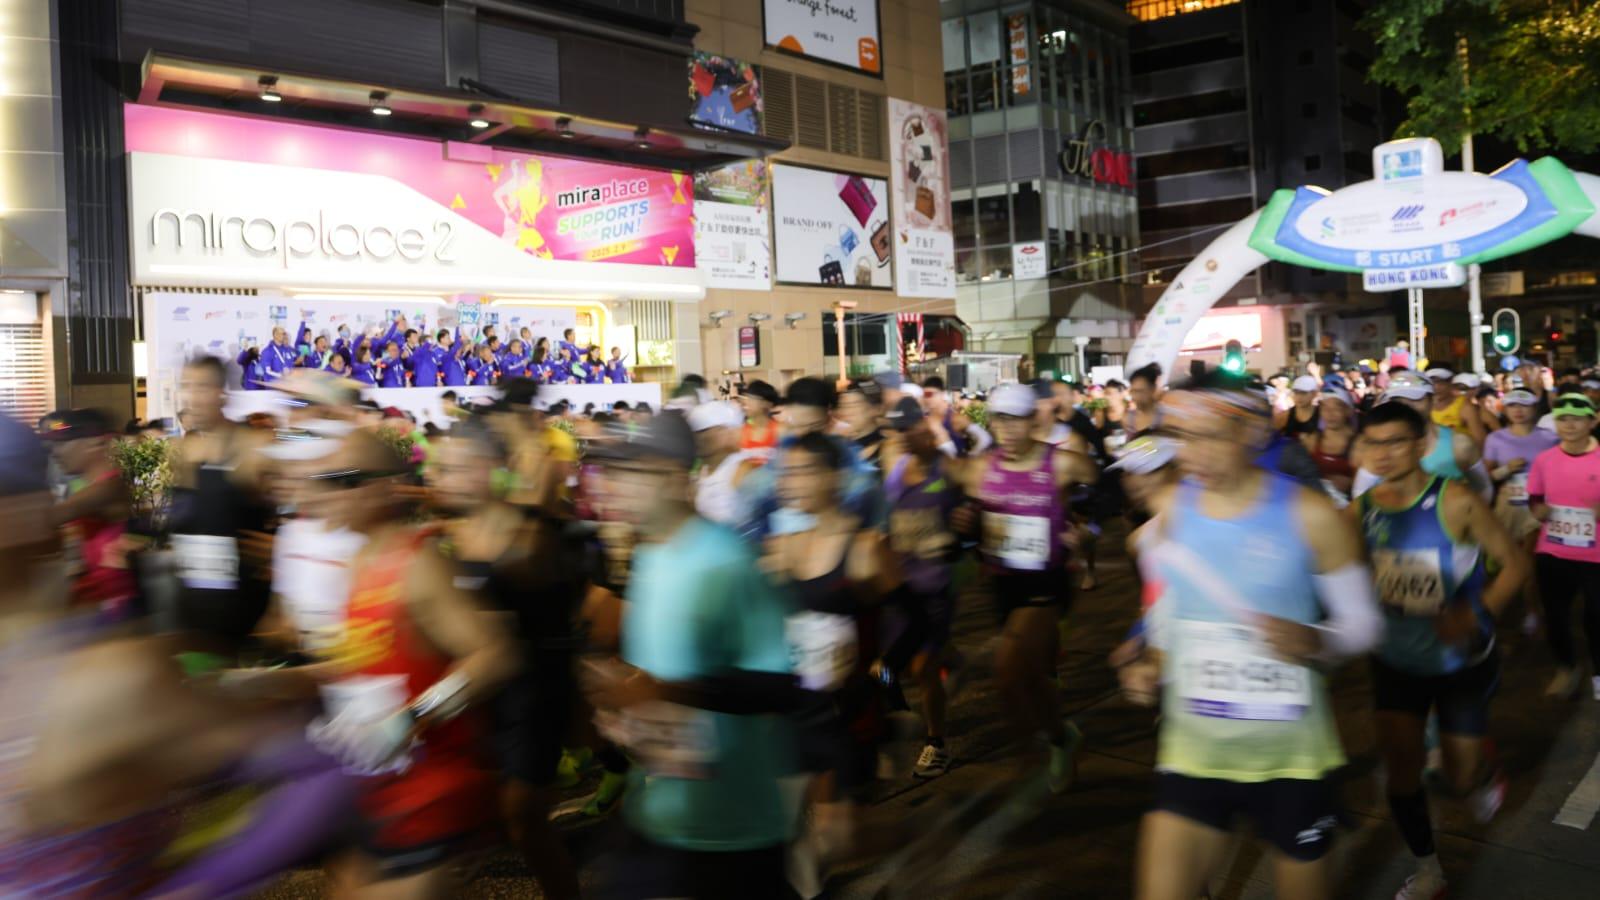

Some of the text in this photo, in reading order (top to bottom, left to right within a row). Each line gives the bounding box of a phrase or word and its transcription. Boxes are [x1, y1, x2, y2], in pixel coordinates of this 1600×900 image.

[558, 179, 648, 208] miraplace
[559, 200, 649, 233] SUPPORTS
[783, 215, 833, 230] BRAND OFF
[148, 206, 456, 269] miraplace 2
[601, 217, 642, 241] RUN!
[1378, 250, 1434, 267] START
[1367, 266, 1449, 287] HONG KONG
